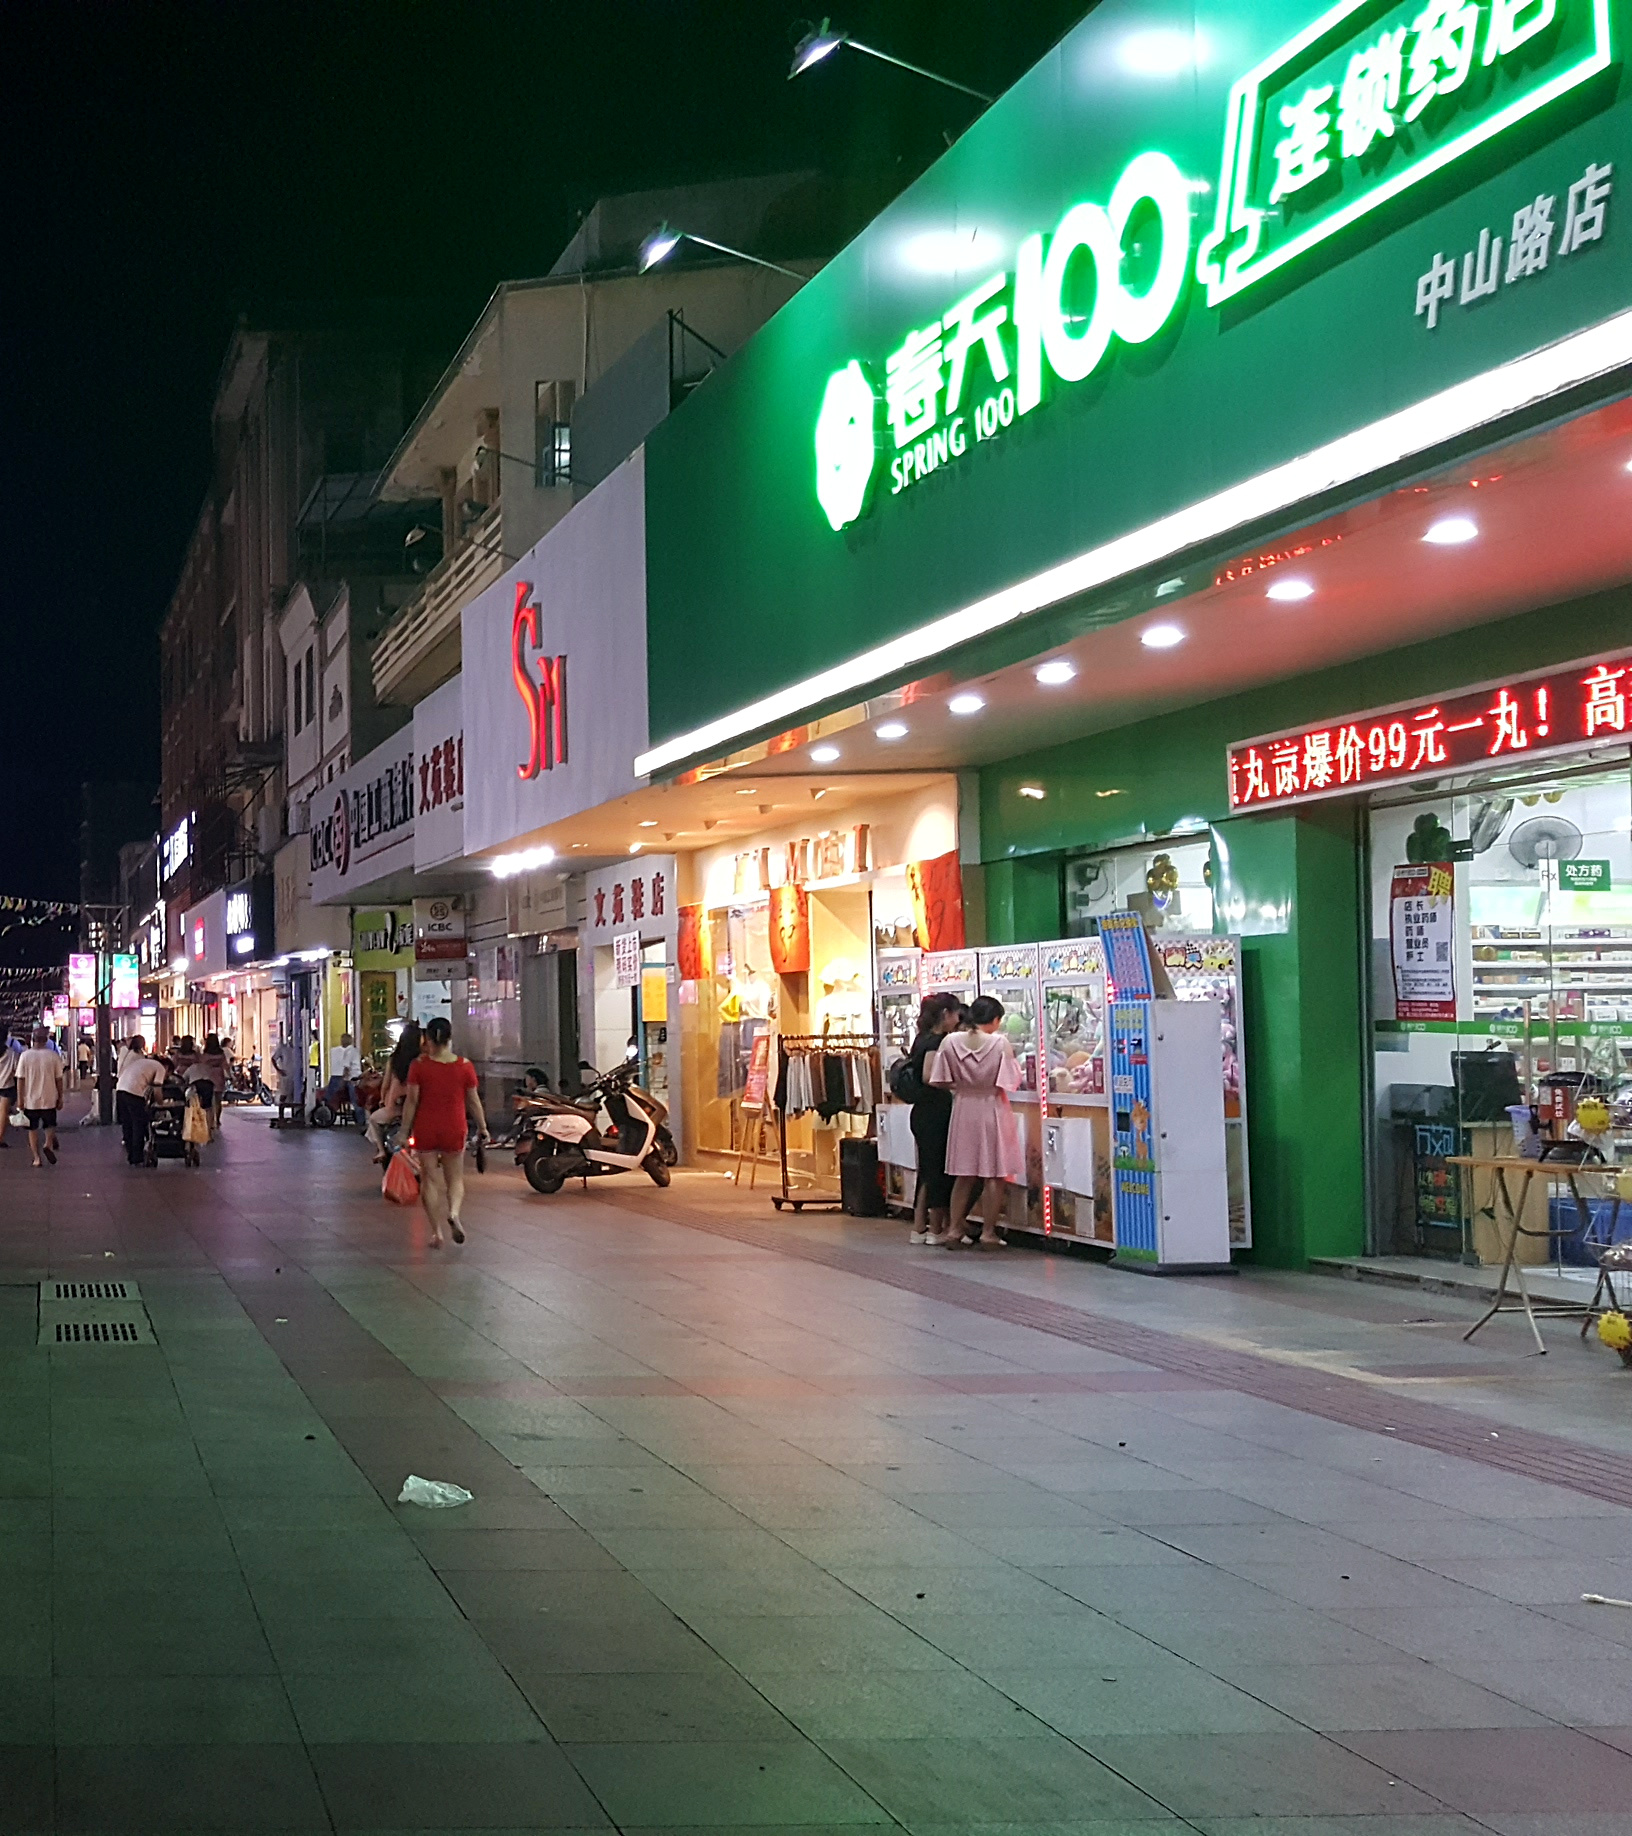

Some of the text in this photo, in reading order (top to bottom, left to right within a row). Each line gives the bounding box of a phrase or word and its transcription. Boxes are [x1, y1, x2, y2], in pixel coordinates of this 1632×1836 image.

[1415, 162, 1613, 329] 中山路店
[891, 388, 1014, 494] SPRING 100
[1581, 664, 1632, 737] 高
[1565, 864, 1603, 878] 处方药
[428, 923, 453, 932] ICBC
